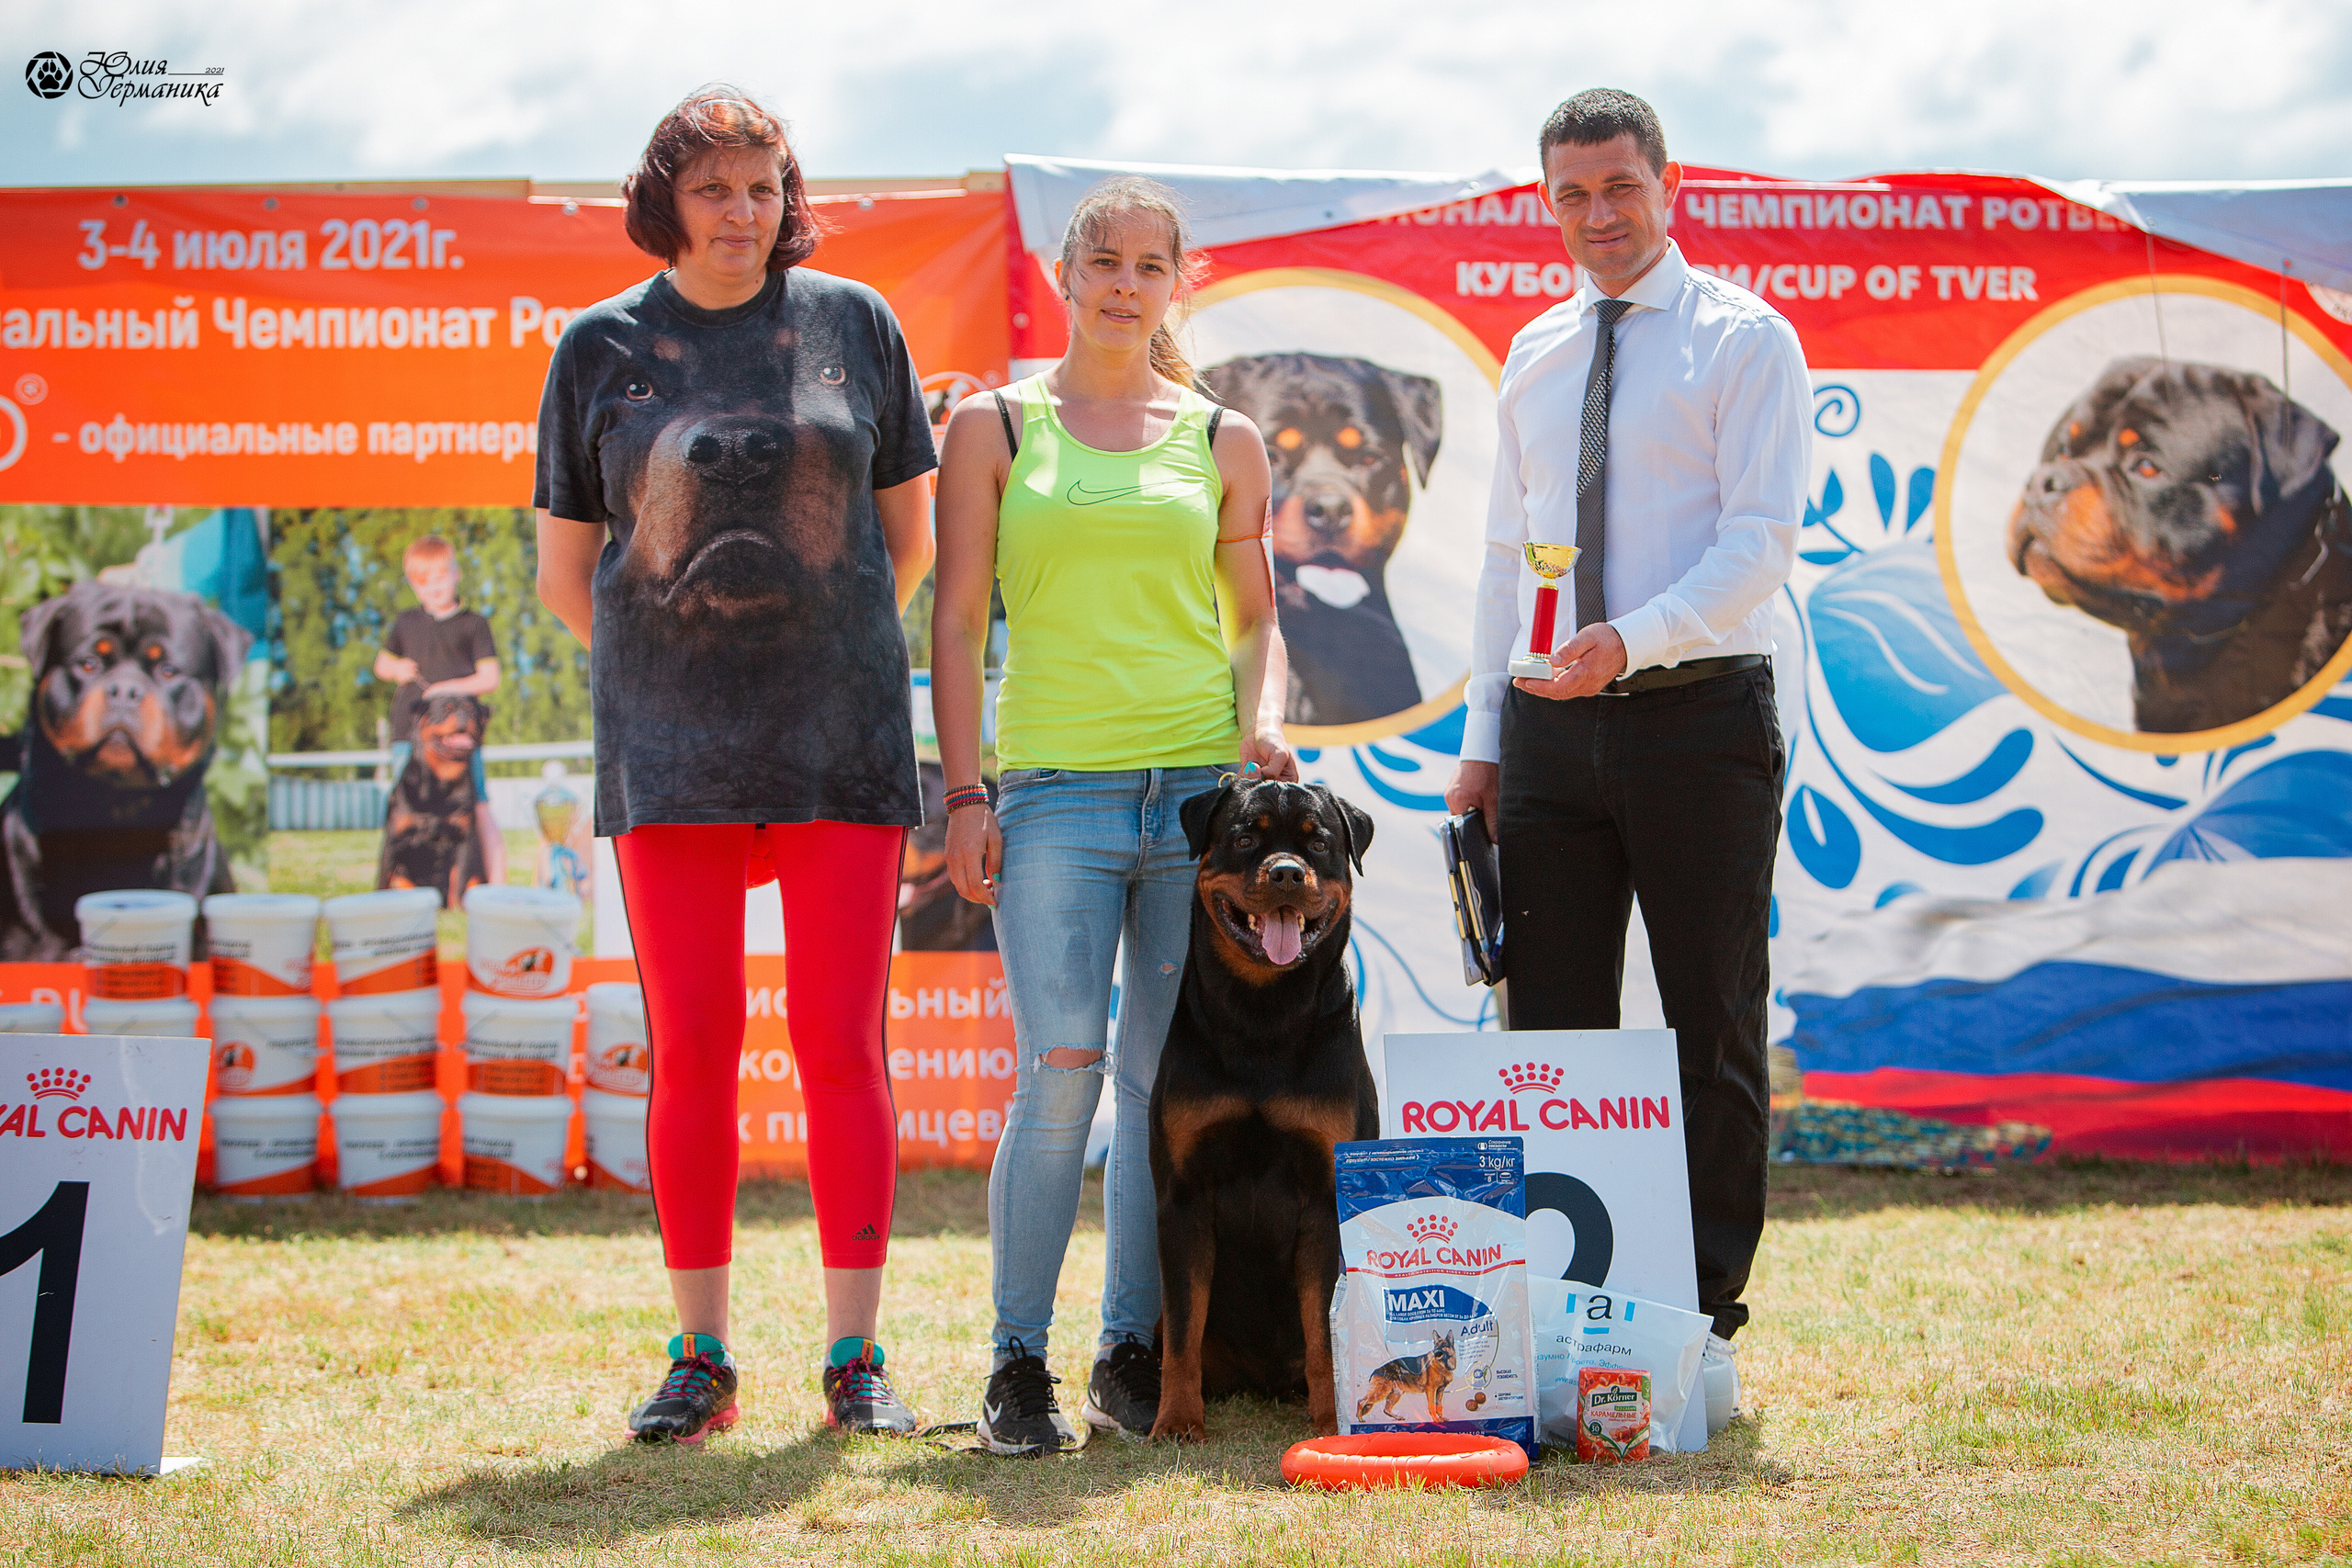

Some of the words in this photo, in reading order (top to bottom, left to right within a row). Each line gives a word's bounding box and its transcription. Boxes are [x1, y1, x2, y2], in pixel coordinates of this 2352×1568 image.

[1685, 194, 1973, 229] ЧЕМПИОНАТ
[1982, 196, 2131, 231] РОТВЕ
[78, 220, 160, 270] 3-4
[173, 229, 306, 270] июля
[320, 220, 463, 270] 2021г.
[1456, 261, 1582, 298] КУБО
[1864, 264, 1921, 300] OF
[1929, 265, 2039, 301] TVER
[212, 299, 497, 348] Чемпионат
[79, 414, 358, 462] официальные
[57, 1105, 187, 1141] CANIN
[1402, 1098, 1531, 1134] ROYAL
[1539, 1096, 1670, 1131] CANIN
[1479, 1156, 1486, 1168] 3
[1366, 1247, 1431, 1269] ROYAL
[1437, 1244, 1501, 1267] CANIN
[0, 1180, 90, 1425] 1
[1387, 1290, 1445, 1312] MAXI
[1461, 1321, 1493, 1337] Adult
[1556, 1335, 1632, 1356] астрафарм
[1591, 1410, 1636, 1419] КАРАМЕЛЬНЫЕ
[1594, 1394, 1606, 1404] Dr.
[1607, 1393, 1635, 1403] Körner
